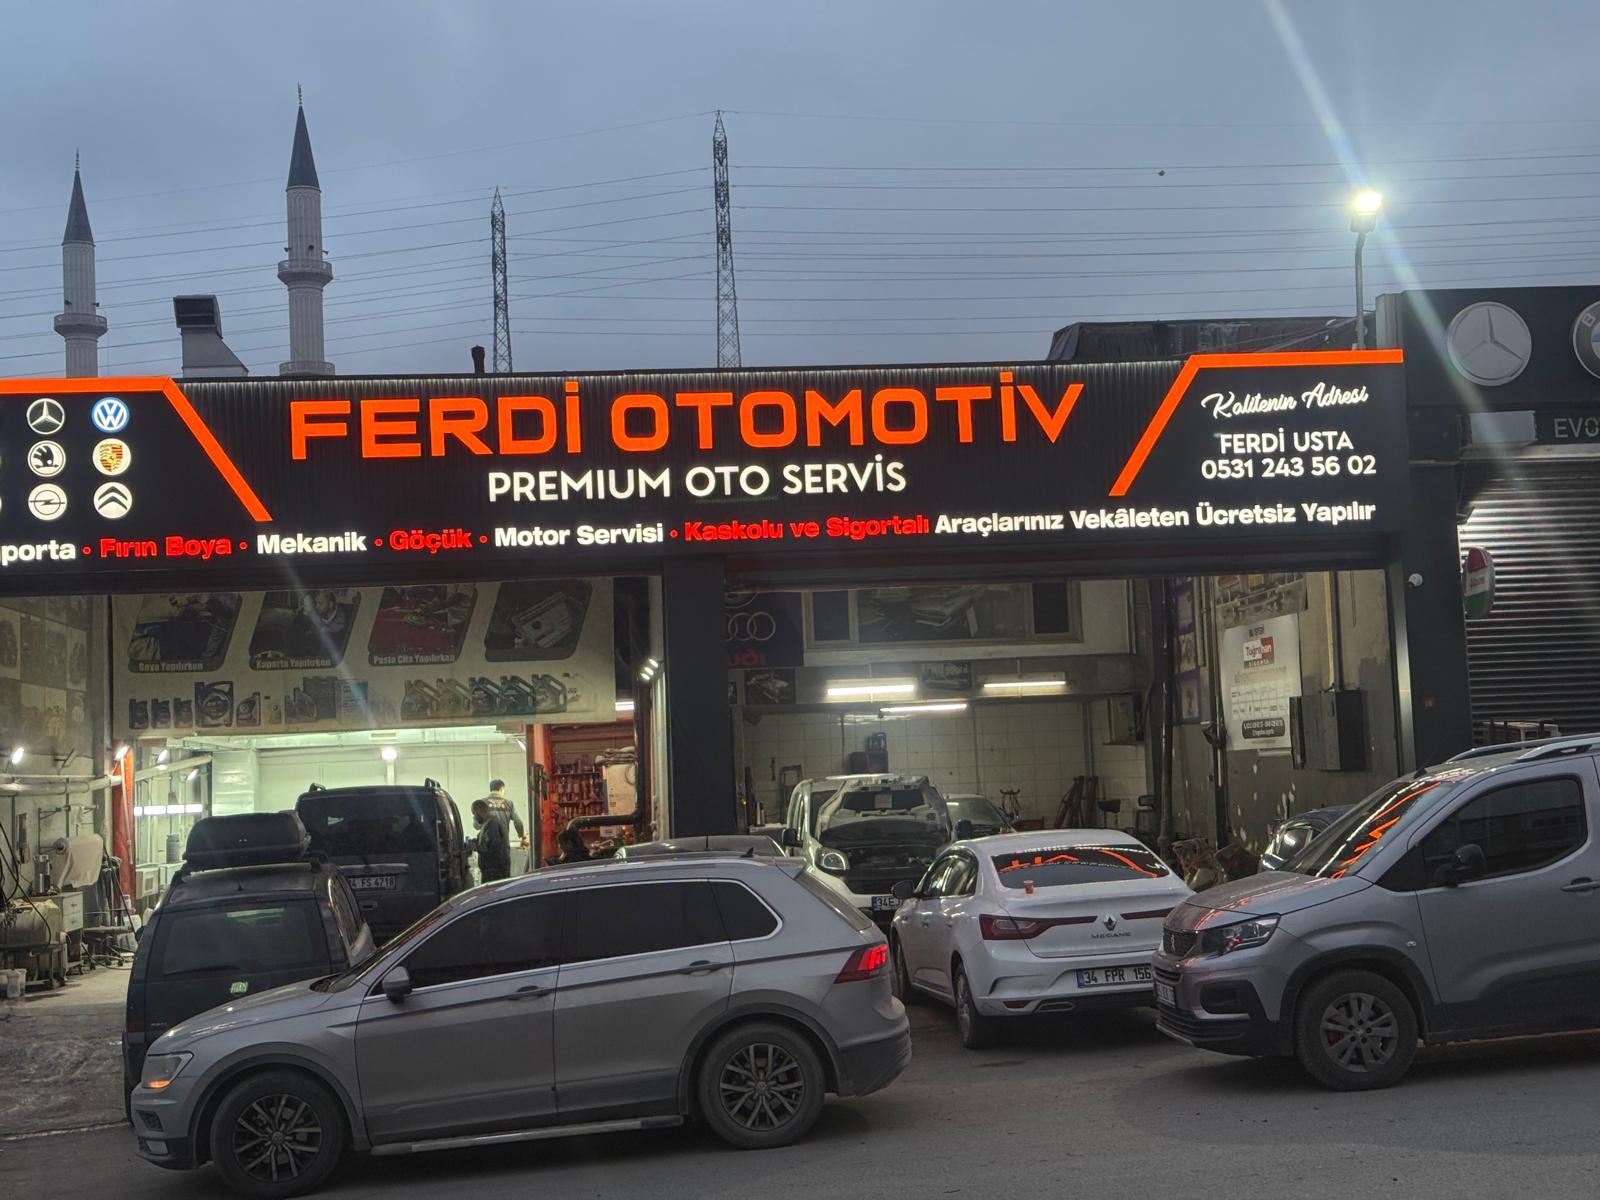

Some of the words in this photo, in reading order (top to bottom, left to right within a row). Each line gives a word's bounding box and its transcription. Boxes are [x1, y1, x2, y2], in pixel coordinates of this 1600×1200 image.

[289, 380, 582, 459] FERDİ
[610, 371, 1085, 452] OTOMOTİV
[1201, 391, 1298, 419] Kalitenin
[1302, 382, 1369, 409] Adresi
[1220, 427, 1285, 454] FERDİ
[1293, 430, 1354, 452] USTA
[489, 466, 671, 502] PREMIUM
[685, 465, 770, 497] OTO
[783, 454, 907, 495] SERVİS
[1201, 459, 1254, 479] 0531
[1261, 457, 1304, 478] 243
[1310, 456, 1341, 476] 56
[1347, 455, 1377, 475] 02
[0, 540, 76, 566] porta
[100, 538, 158, 558] Fırın
[166, 536, 232, 559] Boya
[257, 532, 367, 555] Mekanik
[390, 528, 472, 553] Göçük
[494, 526, 570, 547] Motor
[577, 523, 664, 546] Servisi
[685, 520, 783, 541] Kaskolu
[790, 521, 819, 538] ve
[826, 515, 929, 541] Sigortalı
[935, 512, 1065, 537] Araçlarınız
[1070, 508, 1189, 530] Vekâleten
[1196, 502, 1297, 526] Ücretsiz
[1300, 501, 1377, 526] Yapılır
[1084, 970, 1097, 984] 34
[1104, 968, 1125, 982] FPR
[1133, 967, 1151, 981] 156
